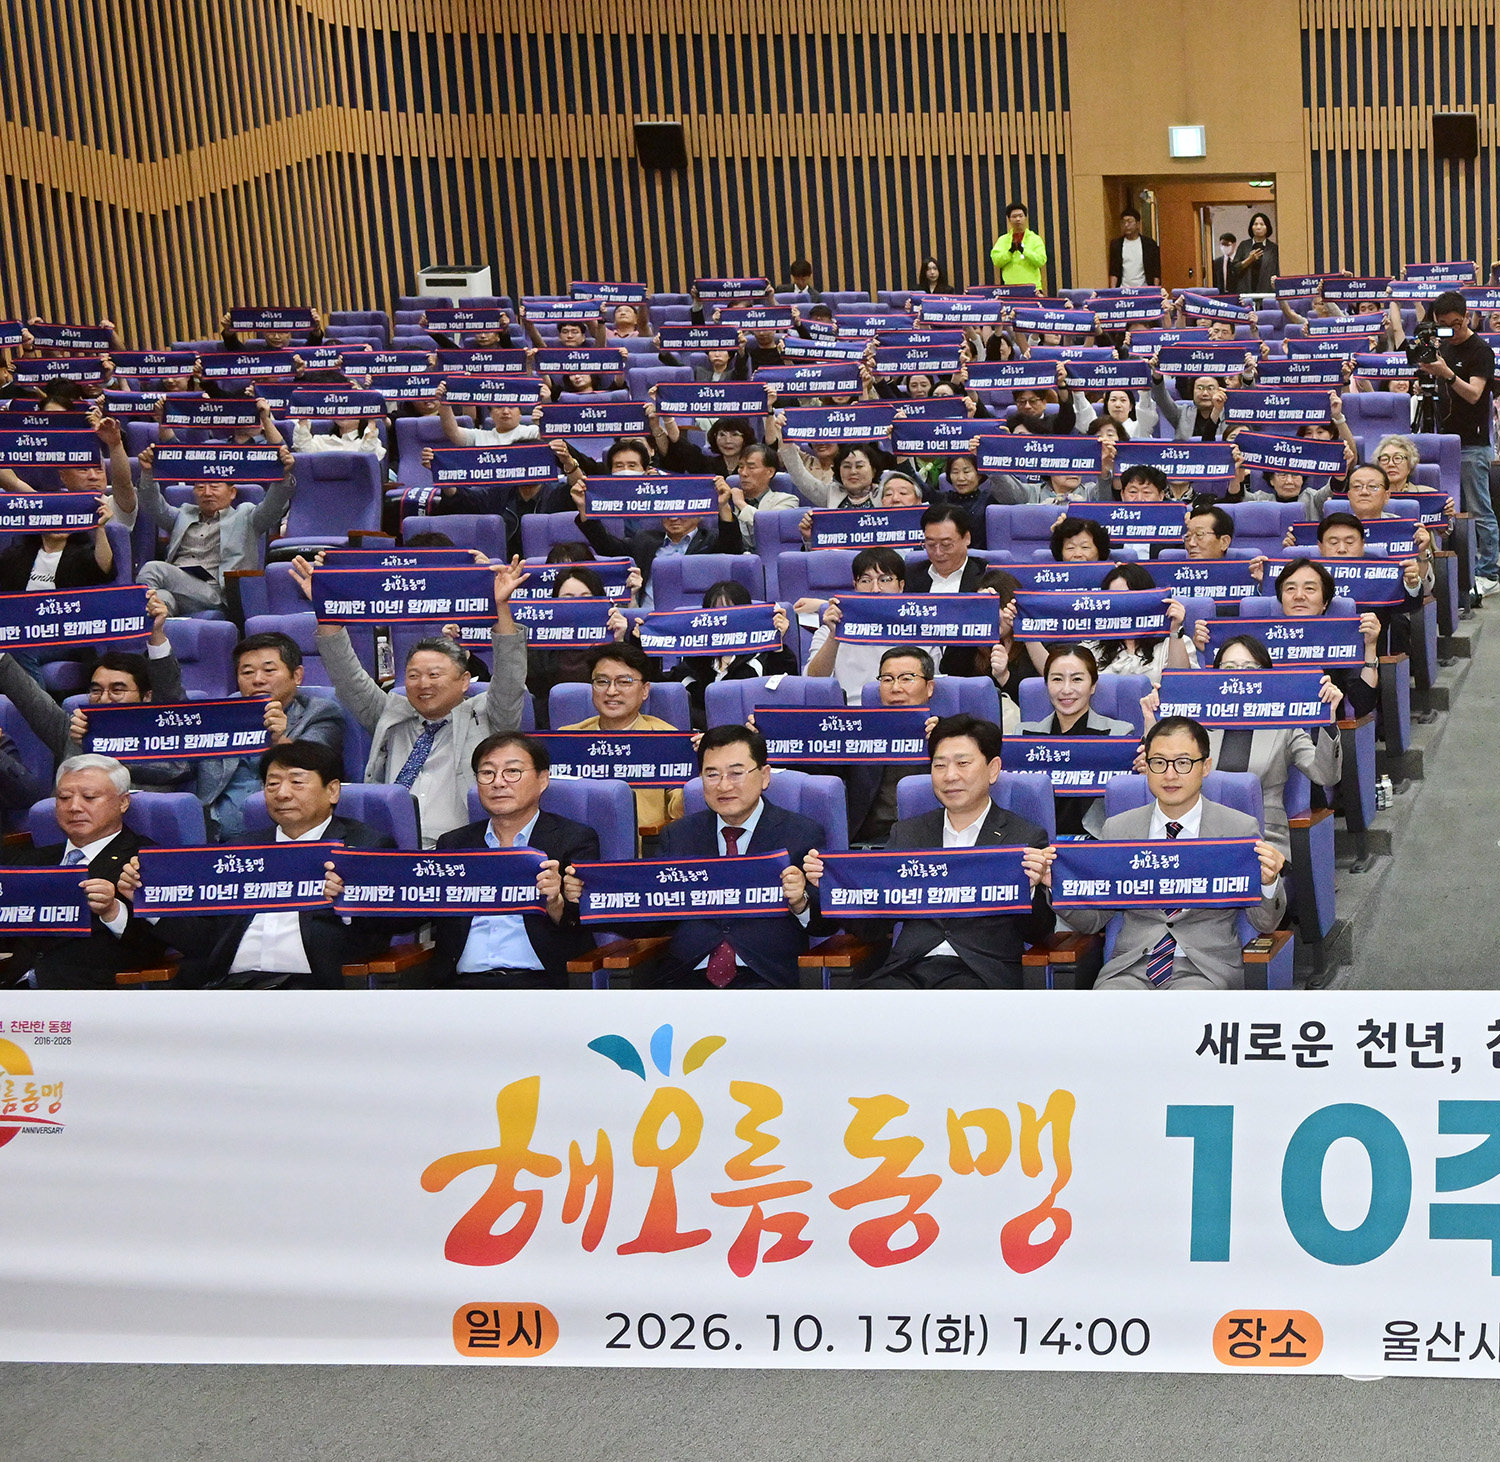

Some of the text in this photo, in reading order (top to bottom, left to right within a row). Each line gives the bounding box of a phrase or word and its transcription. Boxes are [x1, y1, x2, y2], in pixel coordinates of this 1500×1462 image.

[660, 401, 762, 411] 함께한 10년! 함께할 미래!
[591, 498, 711, 511] 함께한 10년! 함께할 미래!
[382, 575, 426, 591] 해오름동맹
[324, 598, 488, 614] 함께한 10년! 함께할 미래!
[898, 602, 937, 616] 해오름동맹
[844, 623, 992, 636] 함께한 10년! 함께할 미래!
[1219, 678, 1262, 694] 해오름동맹
[1159, 700, 1322, 717] 함께한 10년! 함께할 미래!
[155, 711, 201, 727] 해오름동맹
[92, 730, 267, 752] 함께한 10년! 함께할 미래!
[213, 854, 264, 873] 해오름동맹
[1129, 850, 1179, 869] 해오름동맹
[413, 860, 466, 877] 해오름동맹
[656, 868, 708, 883] 해오름동맹
[897, 860, 948, 878] 해오름동맹
[144, 880, 326, 902] 함께한 10년! 함께할 미래
[344, 884, 541, 902] 함께한 10년! 함께할 미래!
[1062, 876, 1249, 896] 함께한 10년! 함께할 미래!
[589, 884, 786, 909] 함께한 10년! 함께할 미래!
[830, 885, 1018, 905] 함께한 10년! 함께할 미래!
[0, 906, 80, 922] 께할 미래!
[11, 1021, 45, 1033] 찬란한
[49, 1021, 71, 1033] 동행
[34, 1037, 71, 1045] 2016-2026
[1196, 1021, 1333, 1068] 새로운
[1357, 1019, 1461, 1073] 천년,
[0, 1079, 64, 1115] 름동맹
[421, 1075, 1076, 1278] 해오름동맹
[466, 1310, 541, 1348] 일시
[606, 1313, 742, 1350] 2026.
[766, 1315, 833, 1351] 10.
[859, 1314, 987, 1355] 13(화)
[1014, 1318, 1150, 1355] 14:00
[1228, 1318, 1306, 1358] 장소
